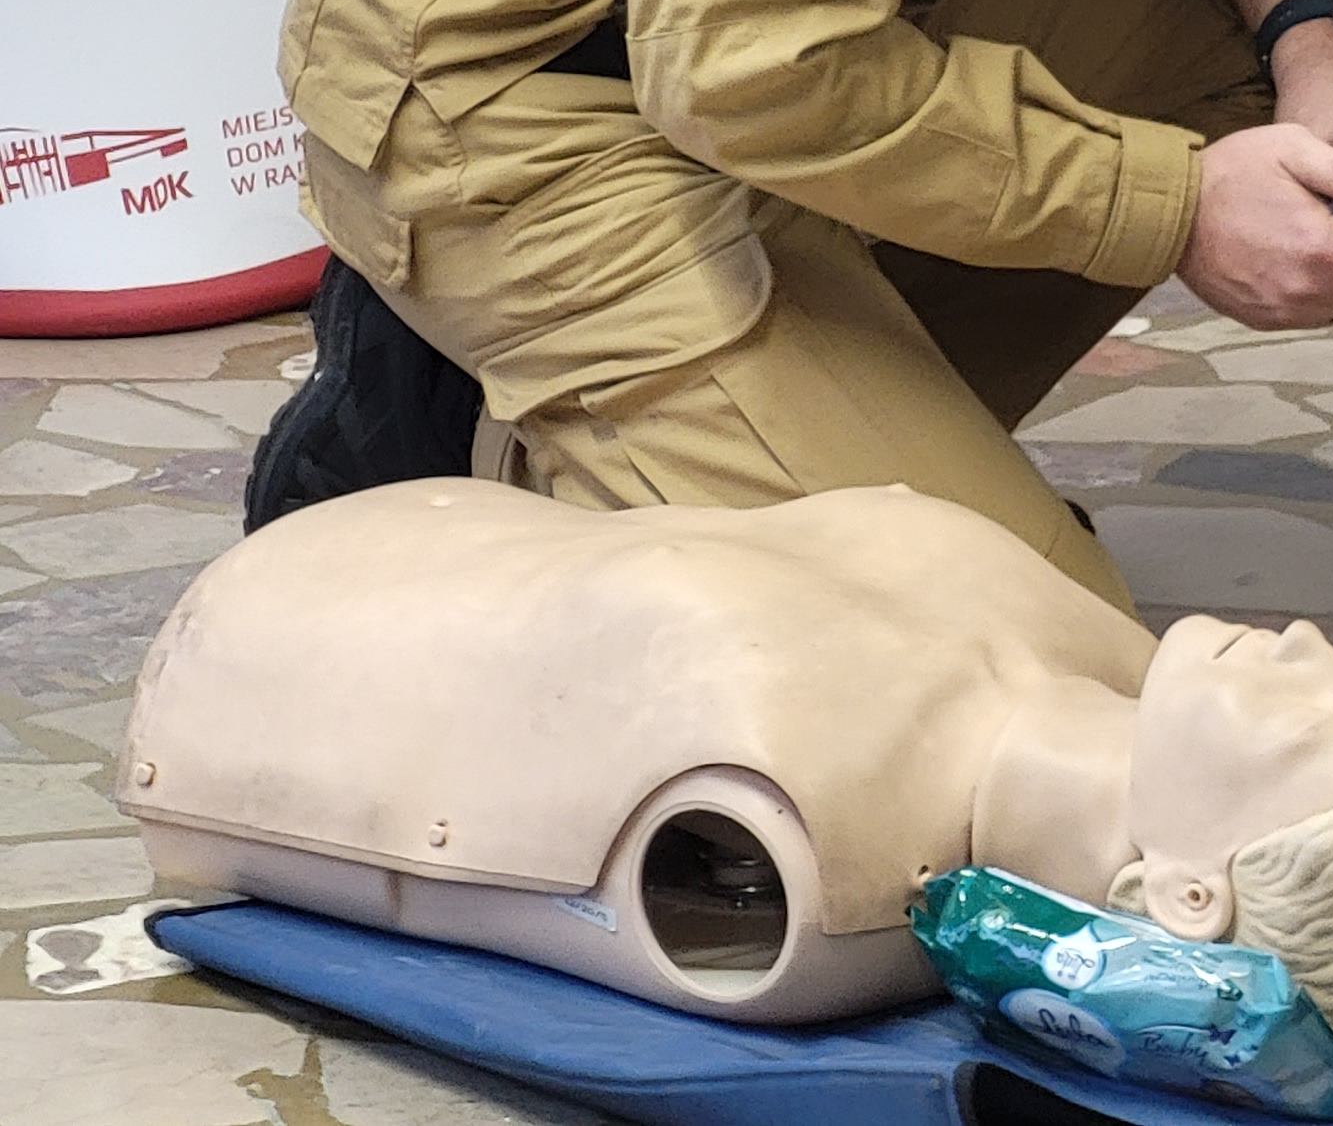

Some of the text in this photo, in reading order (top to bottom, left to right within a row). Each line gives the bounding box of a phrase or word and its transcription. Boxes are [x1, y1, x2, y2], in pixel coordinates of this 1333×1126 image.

[222, 106, 294, 139] MIEJS
[227, 137, 285, 168] DOM
[121, 171, 194, 215] MDK
[231, 173, 255, 195] W
